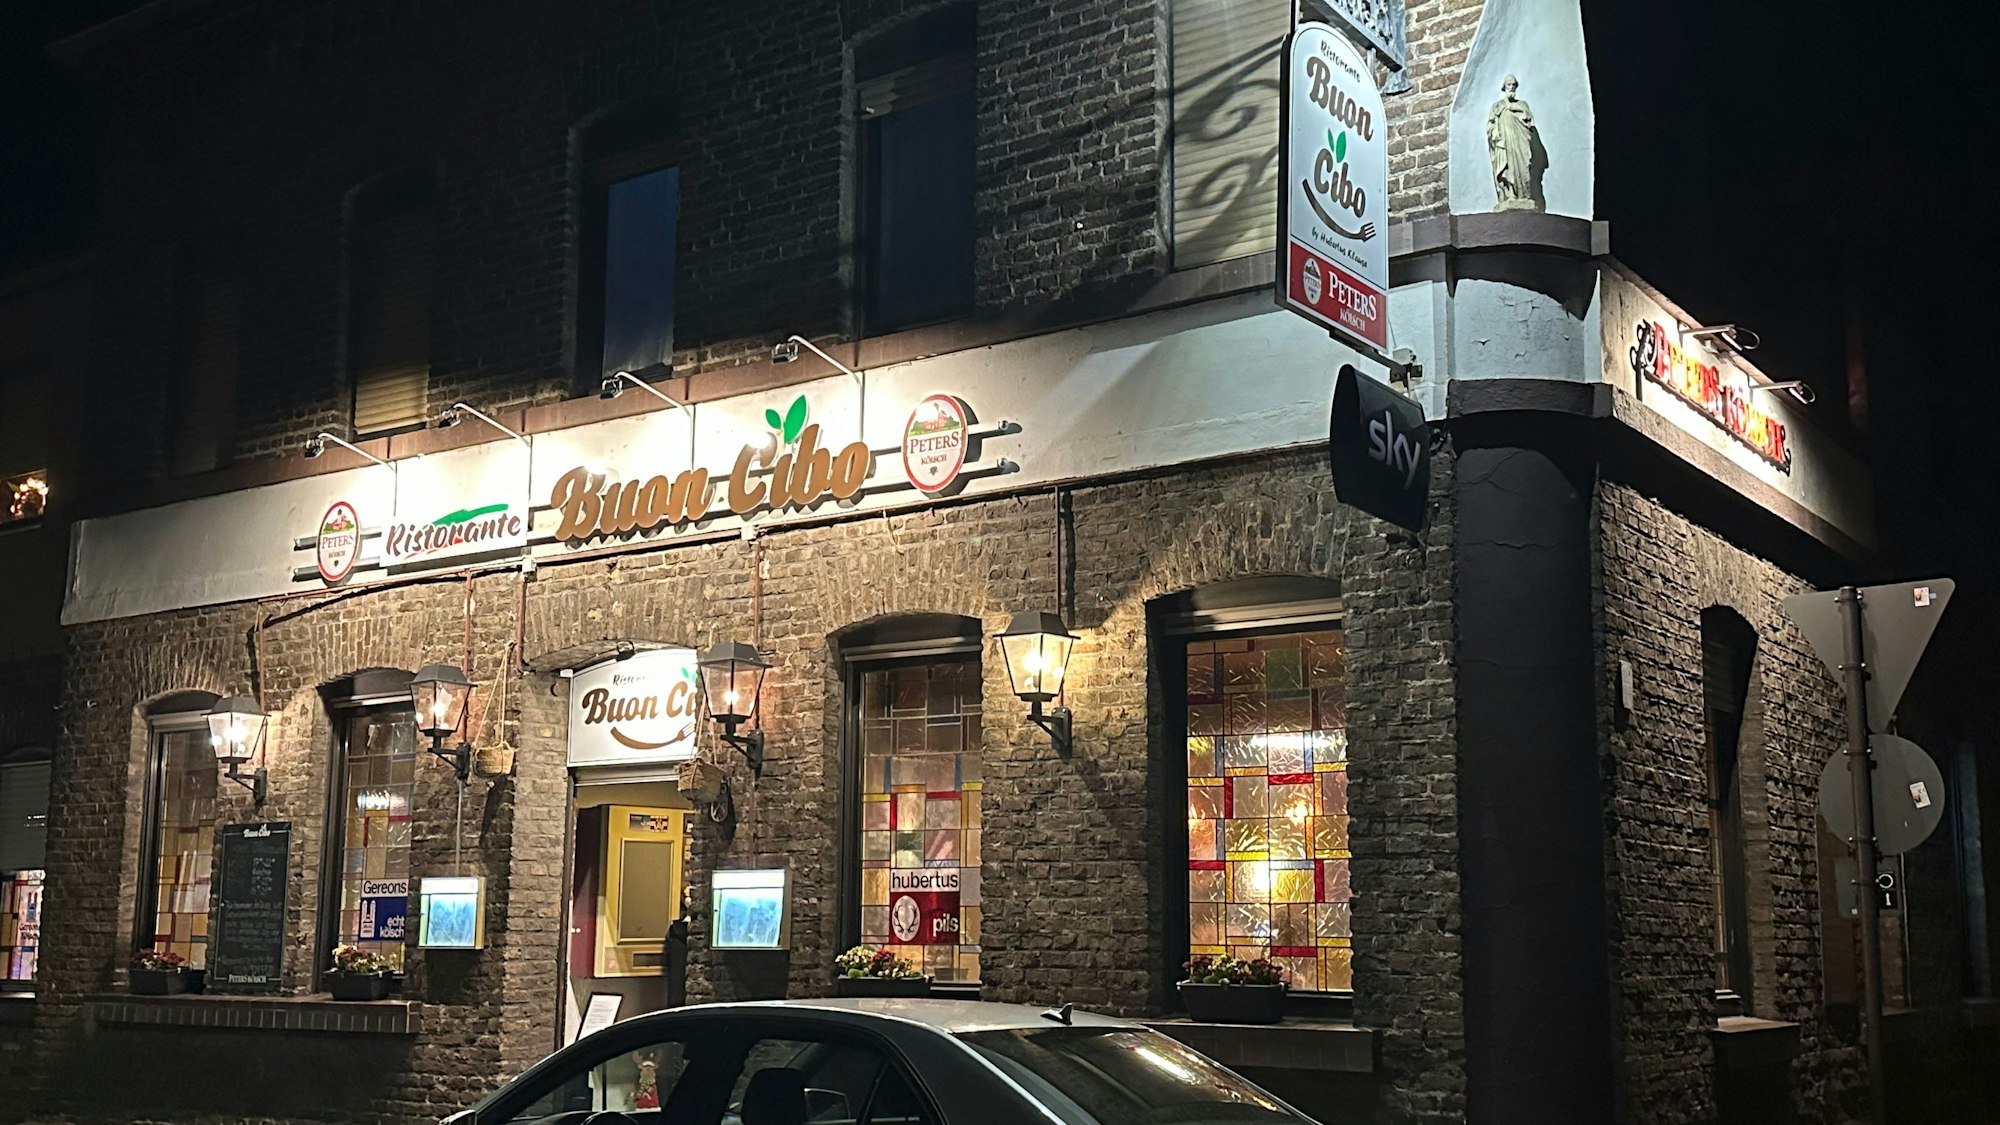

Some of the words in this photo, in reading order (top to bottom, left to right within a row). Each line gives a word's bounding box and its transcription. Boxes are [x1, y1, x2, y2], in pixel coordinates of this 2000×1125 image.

[1321, 40, 1361, 82] Ristorante
[1307, 56, 1374, 142] Buon
[1314, 149, 1366, 218] Cibo
[1311, 226, 1319, 240] by
[1328, 271, 1377, 321] PETERS
[909, 431, 959, 454] PETERS
[1368, 410, 1421, 491] sky
[551, 465, 713, 541] Buon
[728, 424, 869, 514] Cibo
[321, 532, 354, 549] PETERS
[386, 513, 521, 557] Ristorante
[582, 688, 659, 725] Buon
[666, 681, 696, 718] Ci
[363, 880, 407, 894] Gereons
[892, 871, 958, 889] hubertus
[379, 926, 405, 938] kölsch
[387, 915, 405, 926] echt
[932, 913, 959, 937] pils
